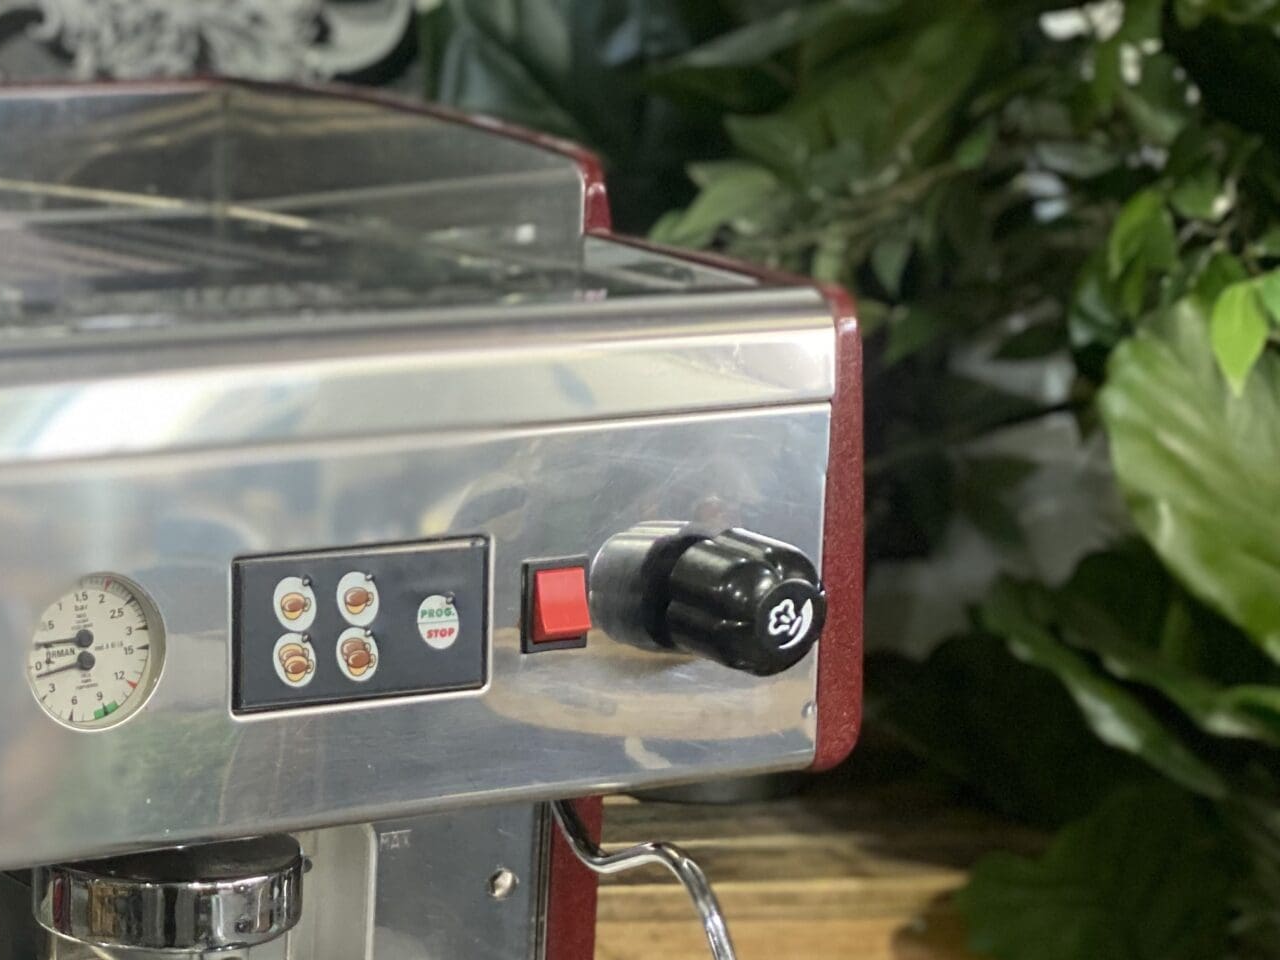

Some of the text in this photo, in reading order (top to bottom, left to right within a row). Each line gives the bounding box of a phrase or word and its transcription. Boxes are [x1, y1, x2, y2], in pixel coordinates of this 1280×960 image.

[421, 607, 455, 619] PROG.
[426, 627, 455, 639] STOP
[114, 671, 125, 681] 12
[71, 695, 78, 706] 6
[96, 691, 103, 702] 9
